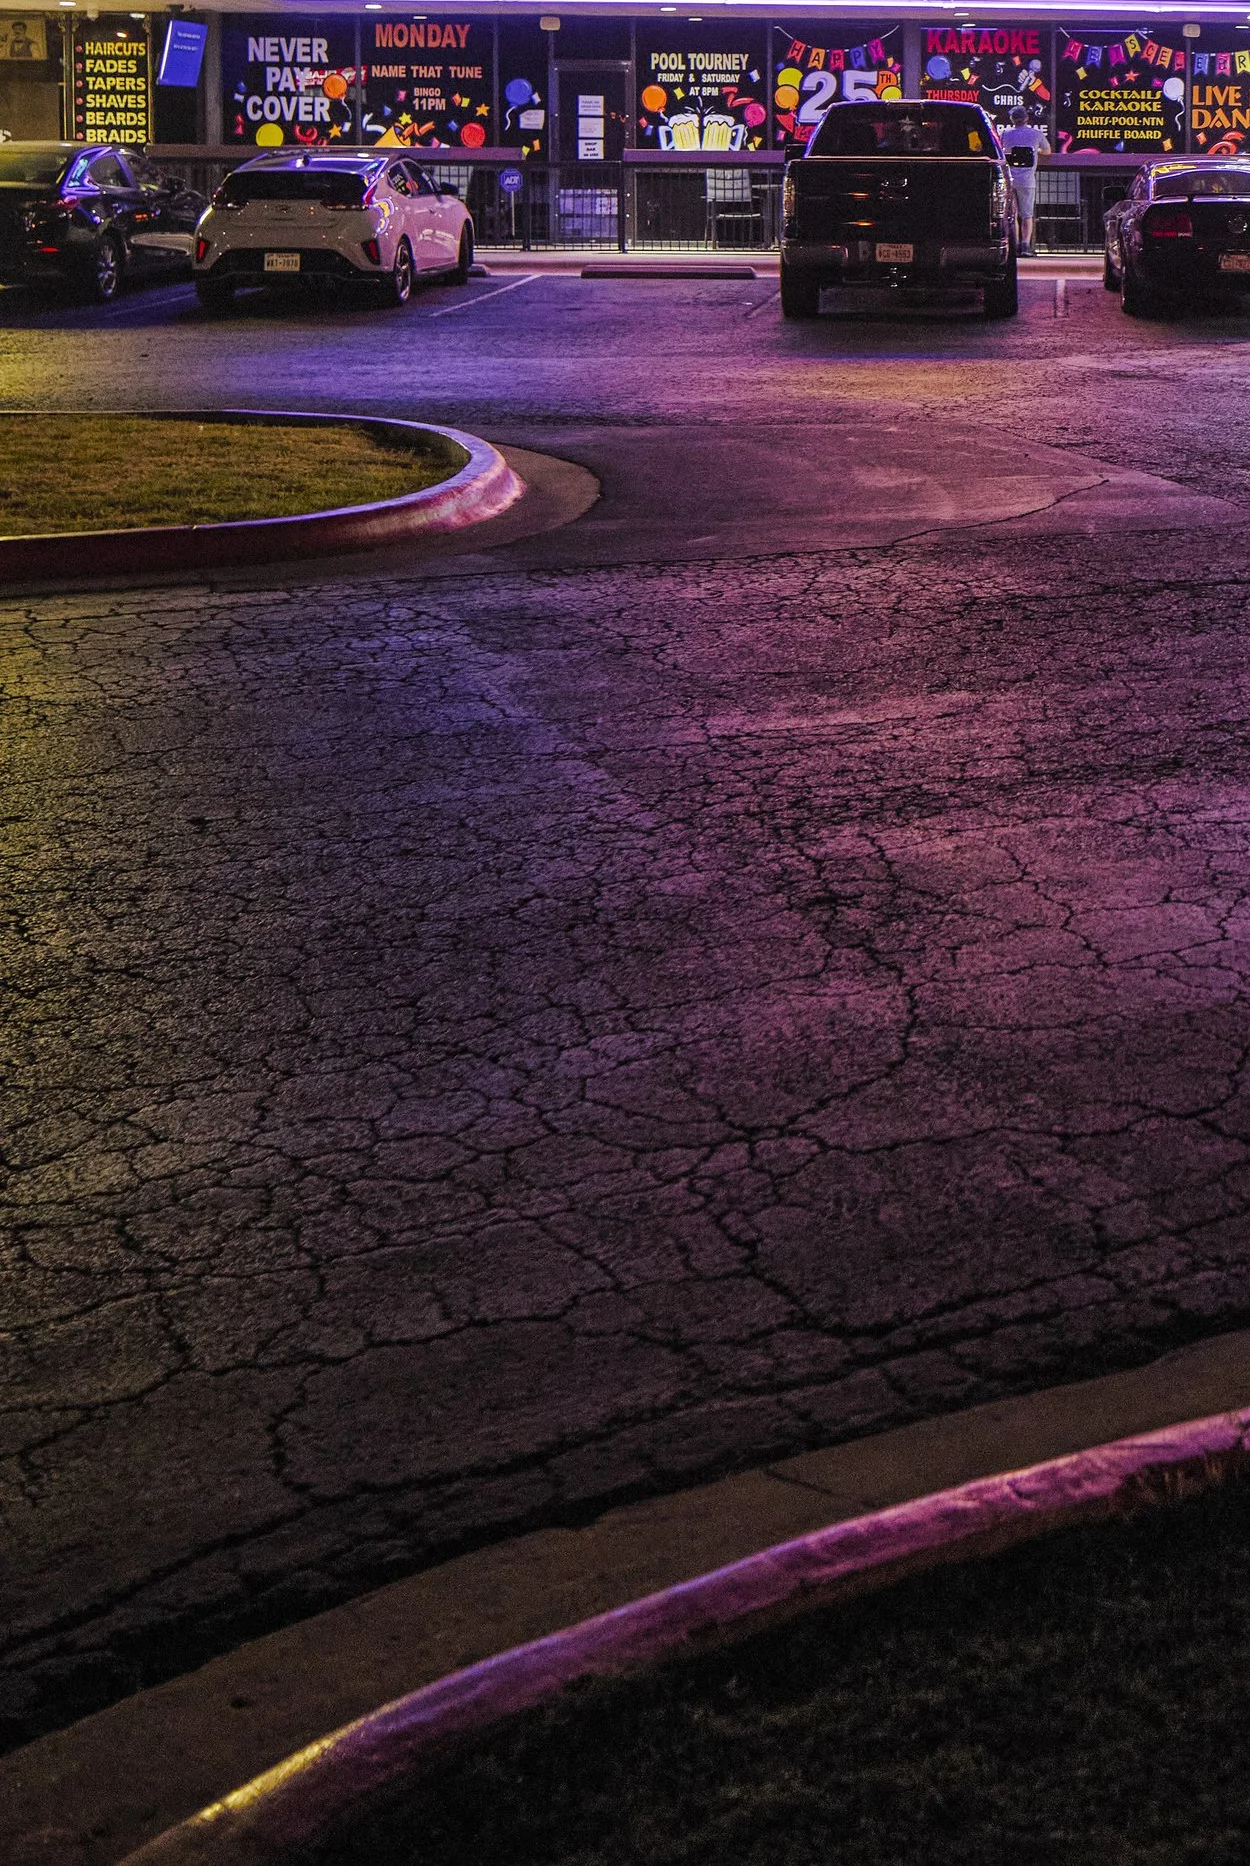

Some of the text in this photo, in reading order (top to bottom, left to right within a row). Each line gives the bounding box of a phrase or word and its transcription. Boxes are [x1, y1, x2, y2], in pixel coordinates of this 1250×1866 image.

[375, 23, 471, 48] MONDAY
[927, 29, 1040, 54] KARAOKE
[85, 42, 146, 56] HAIRCUTS
[248, 37, 329, 63] NEVER
[790, 41, 881, 64] HAPPY
[85, 60, 137, 73] FADES
[651, 53, 749, 71] POOL TOURNEY
[371, 65, 482, 79] NAME THAT TUNE
[657, 73, 740, 83] FRIDAY & SATURDAY
[85, 77, 146, 91] TAPERS
[266, 67, 310, 92] PAY
[414, 87, 441, 97] BINGO
[689, 87, 719, 96] AT 8PM
[798, 71, 892, 123] 25 TH
[926, 89, 979, 102] THURSDAY
[1079, 90, 1162, 100] COCKTAILS
[1192, 85, 1242, 106] LIVE
[86, 94, 146, 108] SHAVES
[413, 98, 446, 111] 11PM
[994, 95, 1024, 105] CHRIS
[1080, 101, 1162, 111] KARAOKE
[246, 95, 331, 122] COVER
[86, 112, 146, 126] BEARDS
[86, 129, 147, 143] BRAIDS
[1076, 129, 1162, 139] SHUFFLE BOARD
[504, 175, 520, 185] ADT
